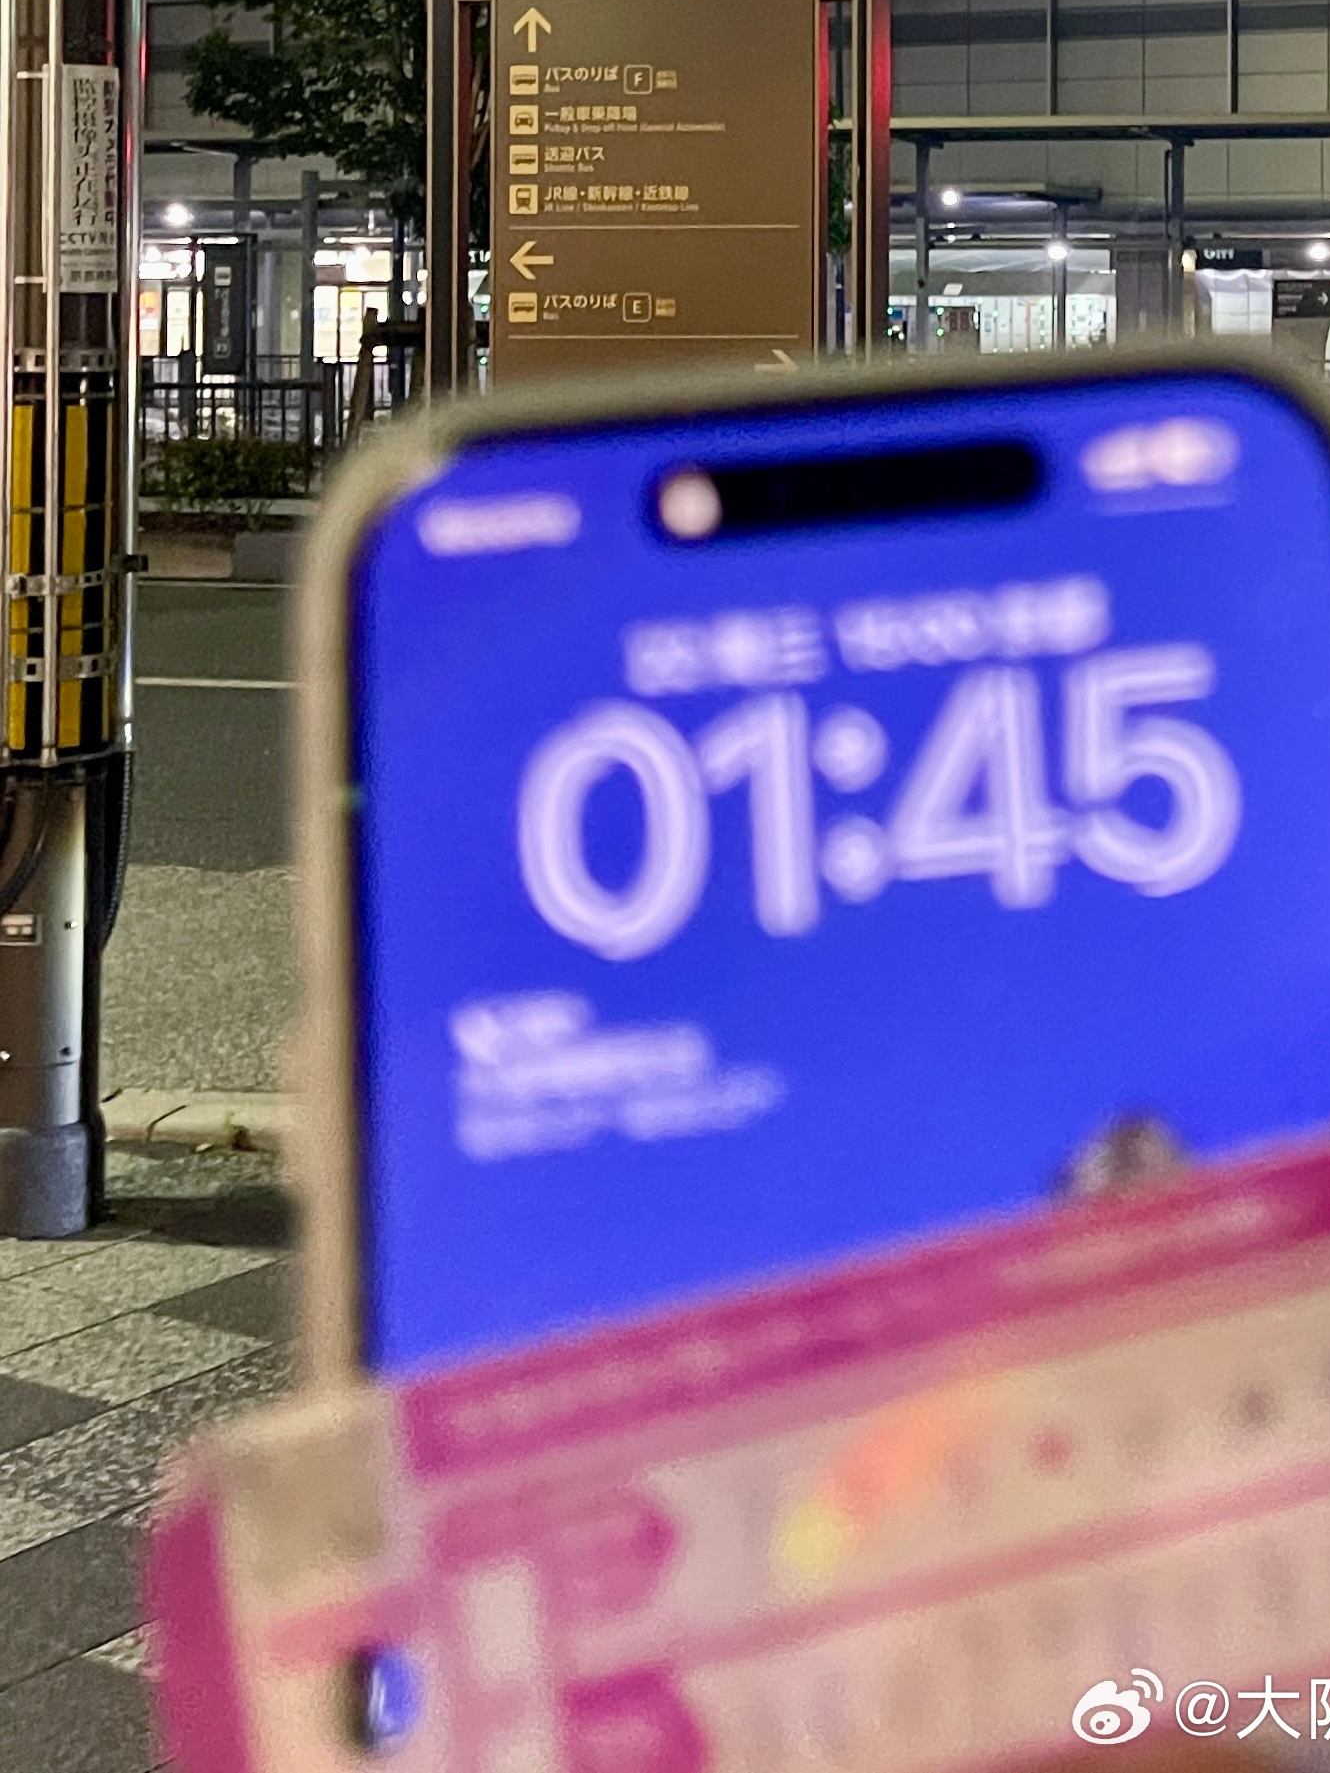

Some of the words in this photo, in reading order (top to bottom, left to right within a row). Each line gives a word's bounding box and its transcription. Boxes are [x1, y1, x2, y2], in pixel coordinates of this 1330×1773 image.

[545, 65, 619, 82] バスのりば
[543, 293, 618, 309] バスのりば
[519, 642, 1242, 962] 01:45
